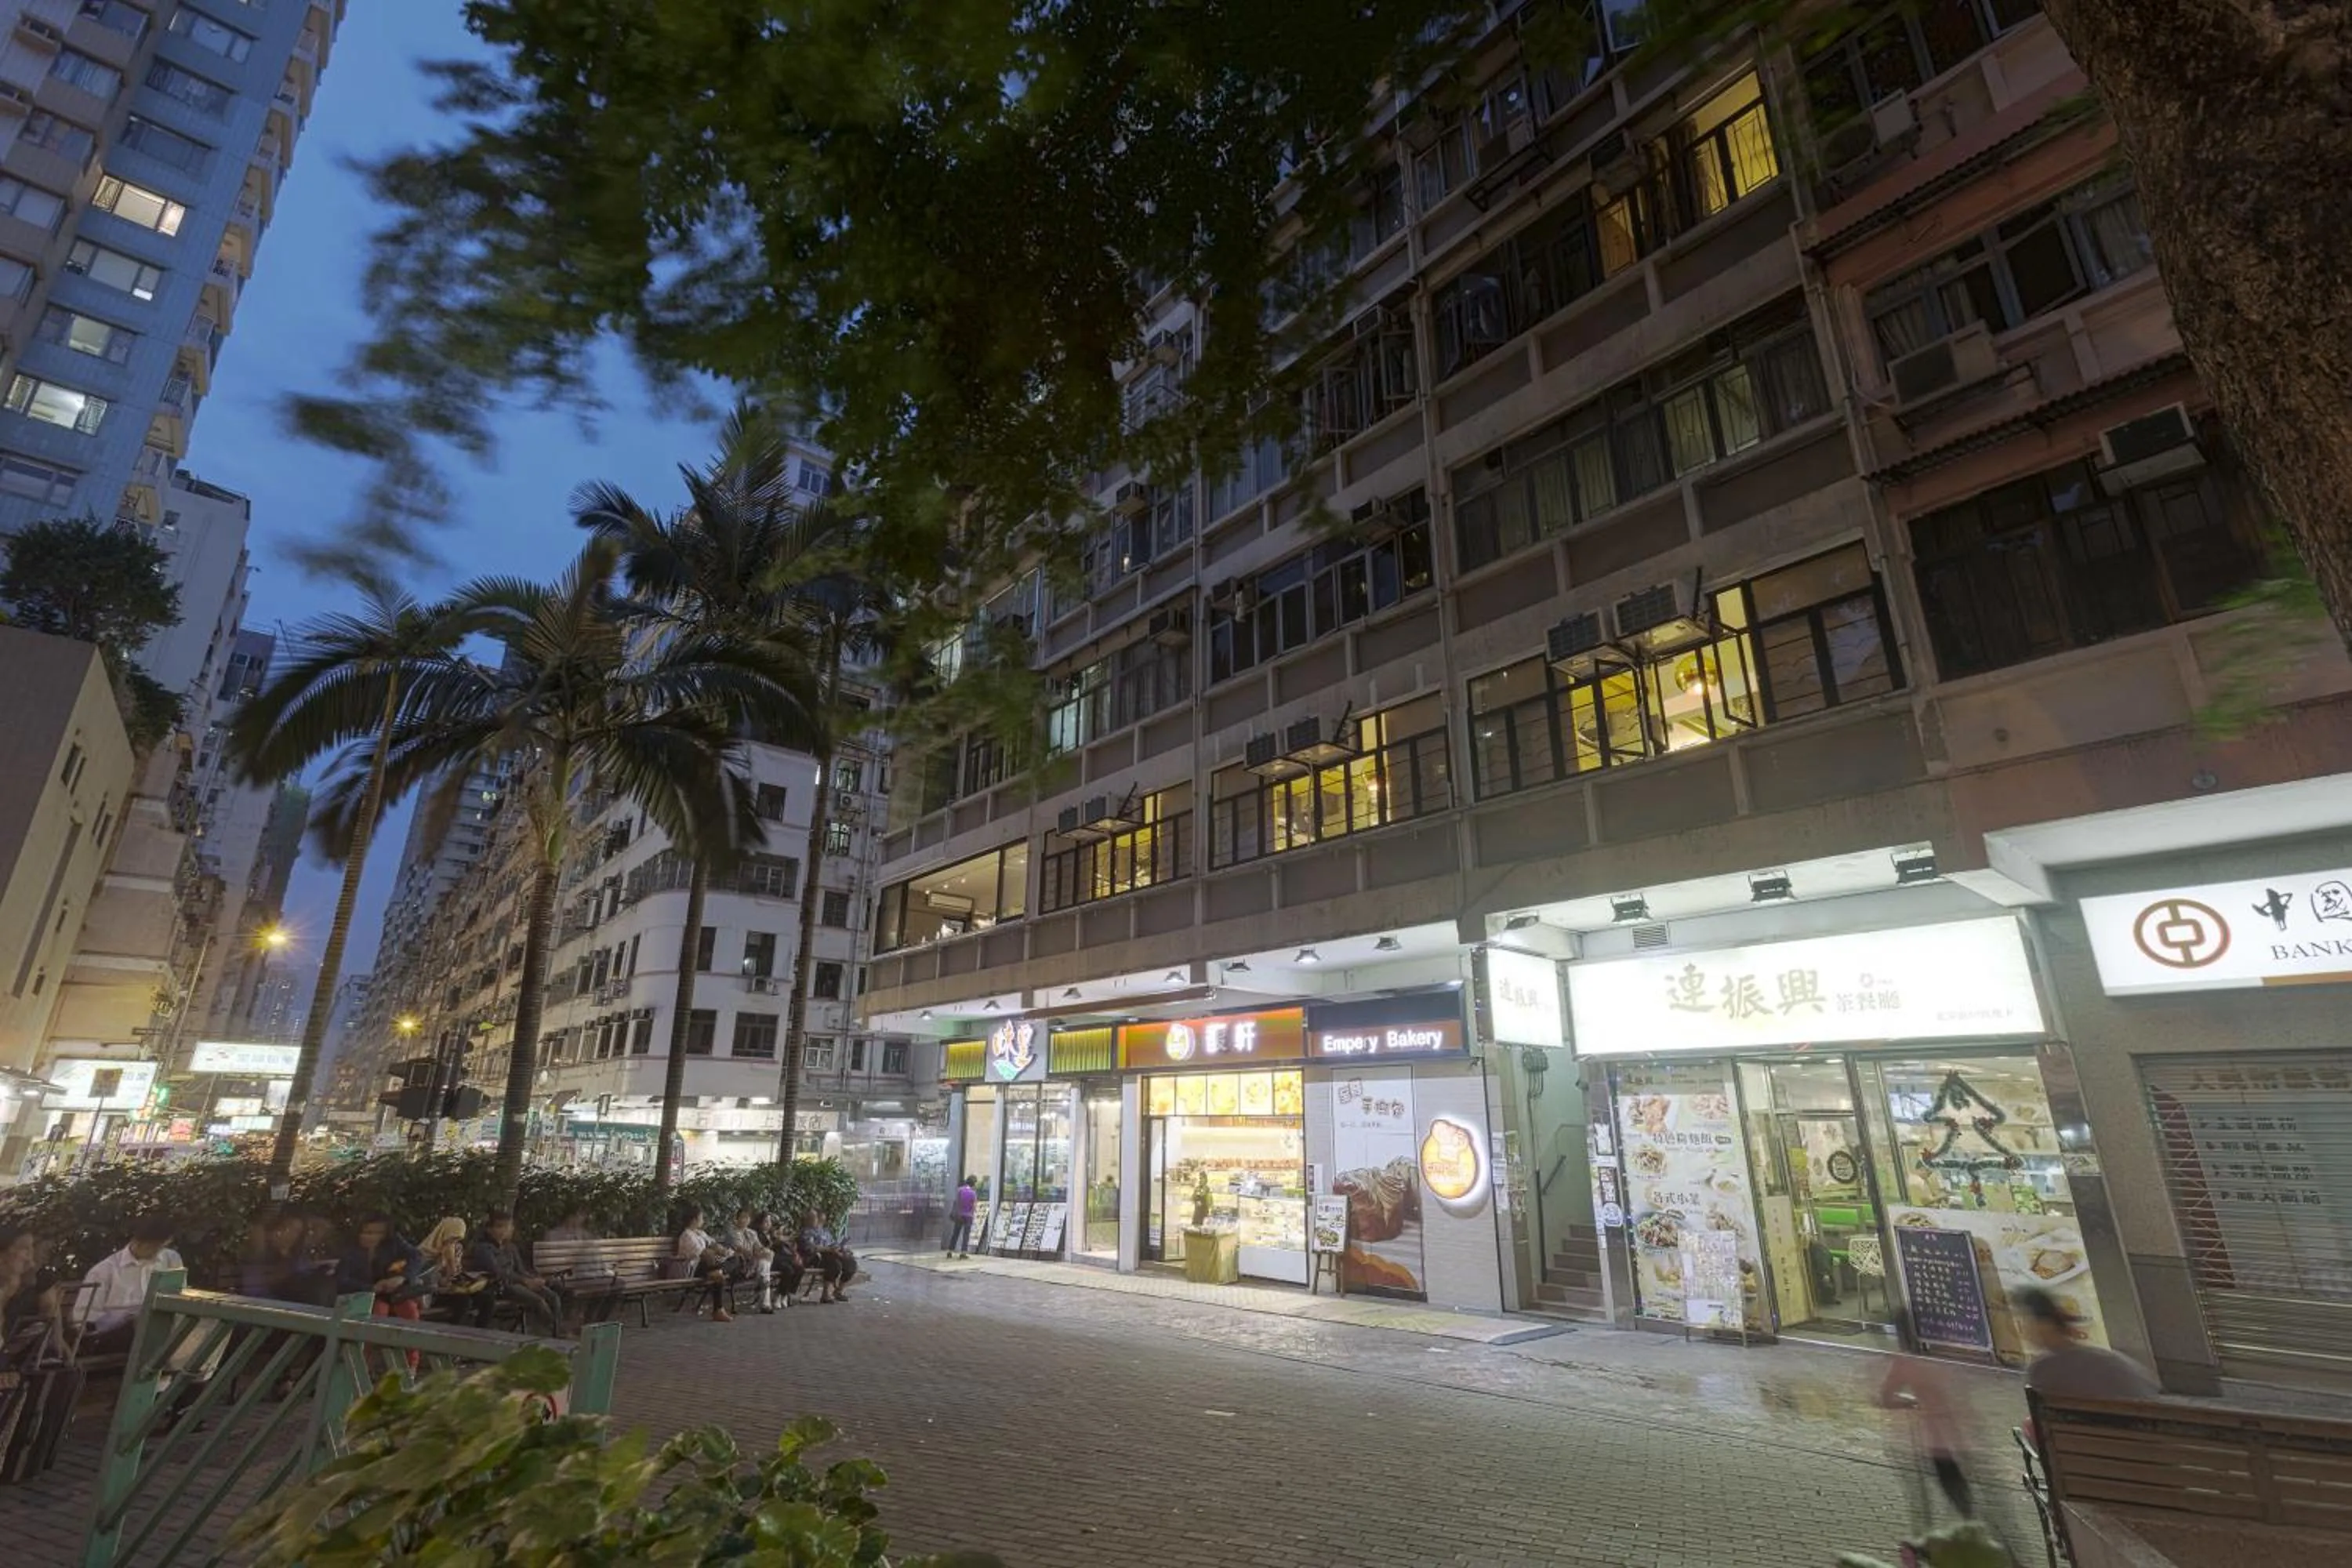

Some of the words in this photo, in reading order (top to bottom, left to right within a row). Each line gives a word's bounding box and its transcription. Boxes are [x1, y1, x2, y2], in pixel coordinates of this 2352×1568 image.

[2251, 880, 2352, 931] 中國
[2270, 939, 2352, 960] BANK
[1664, 963, 1827, 1019] 連振興
[1323, 1034, 1377, 1053] Empery
[1387, 1029, 1443, 1051] Bakery
